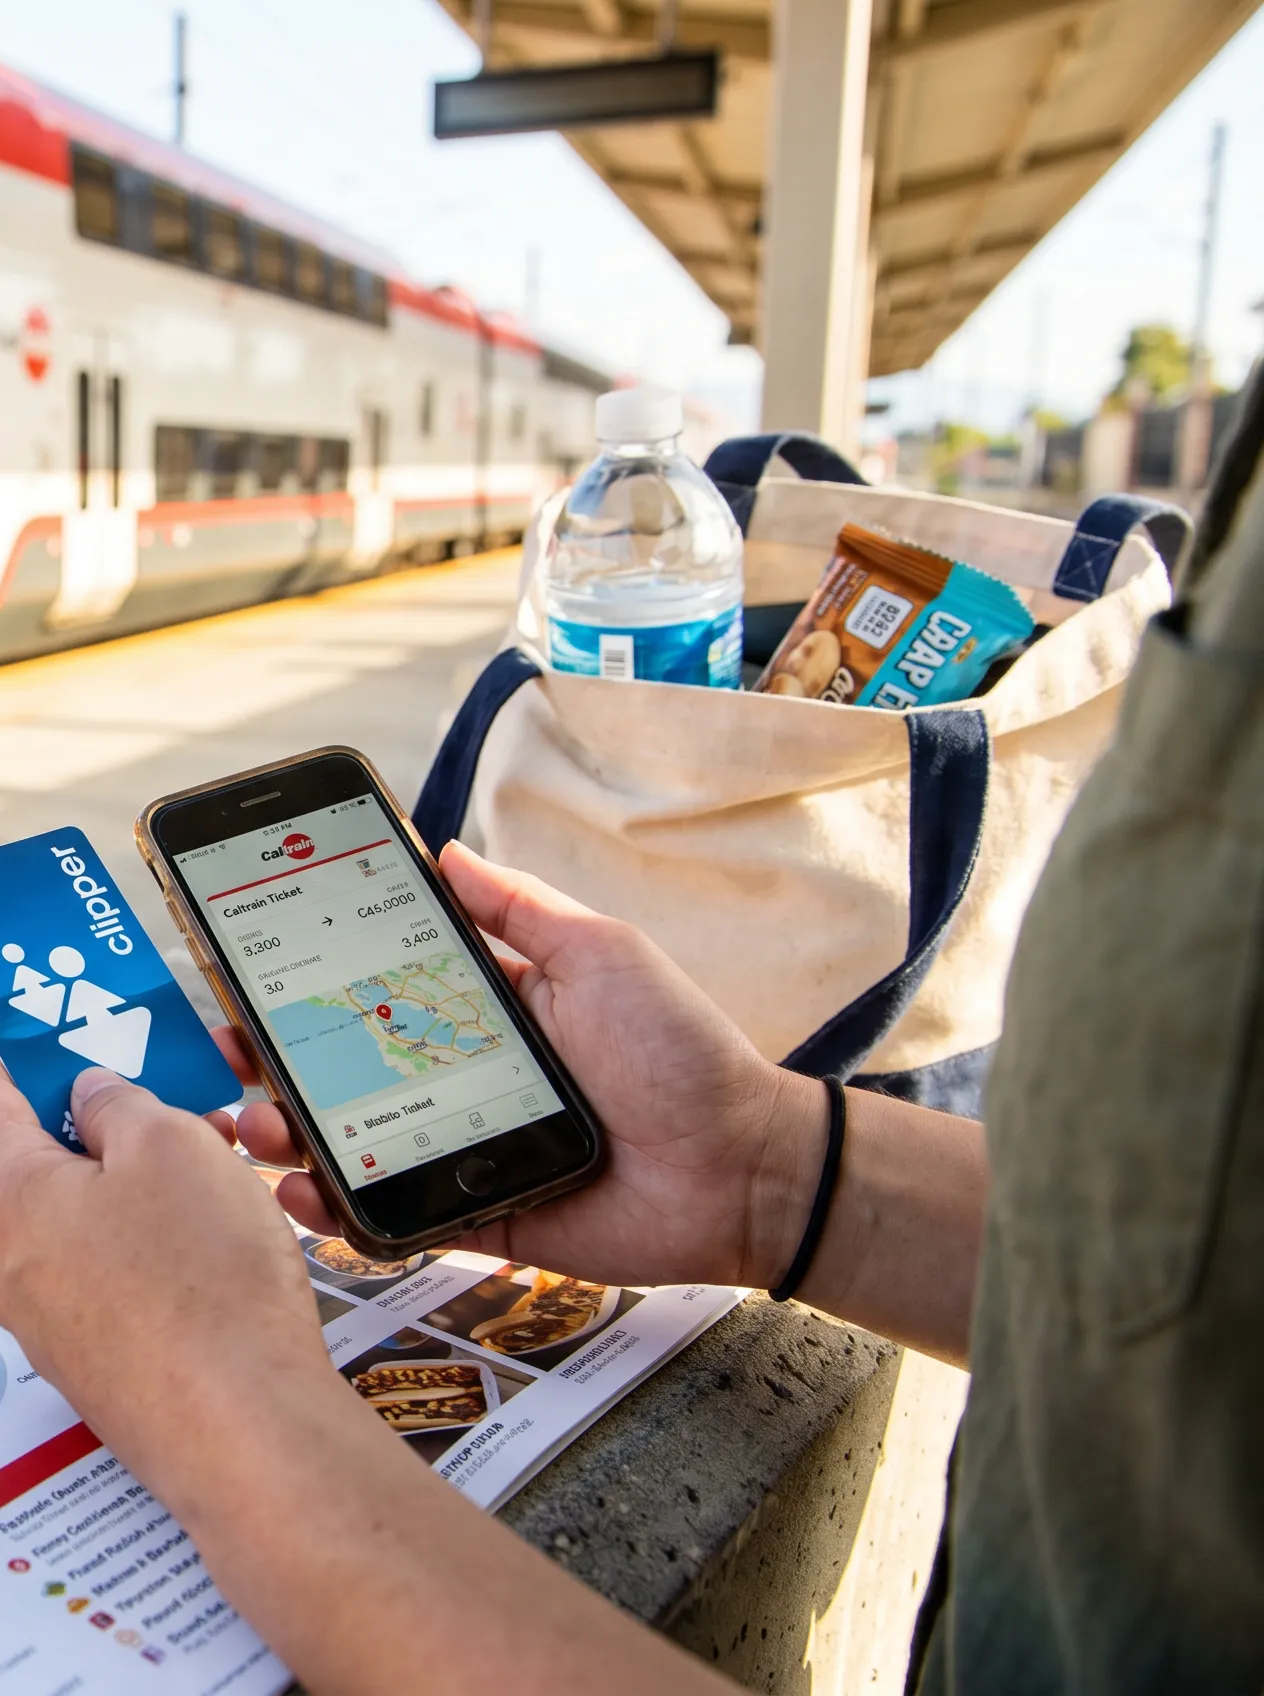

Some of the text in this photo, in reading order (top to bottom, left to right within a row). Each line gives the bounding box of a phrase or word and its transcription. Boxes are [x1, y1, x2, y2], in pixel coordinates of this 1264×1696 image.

[261, 838, 314, 861] Caltrain
[51, 846, 133, 955] clipper
[223, 885, 303, 918] Caltrain Ticket
